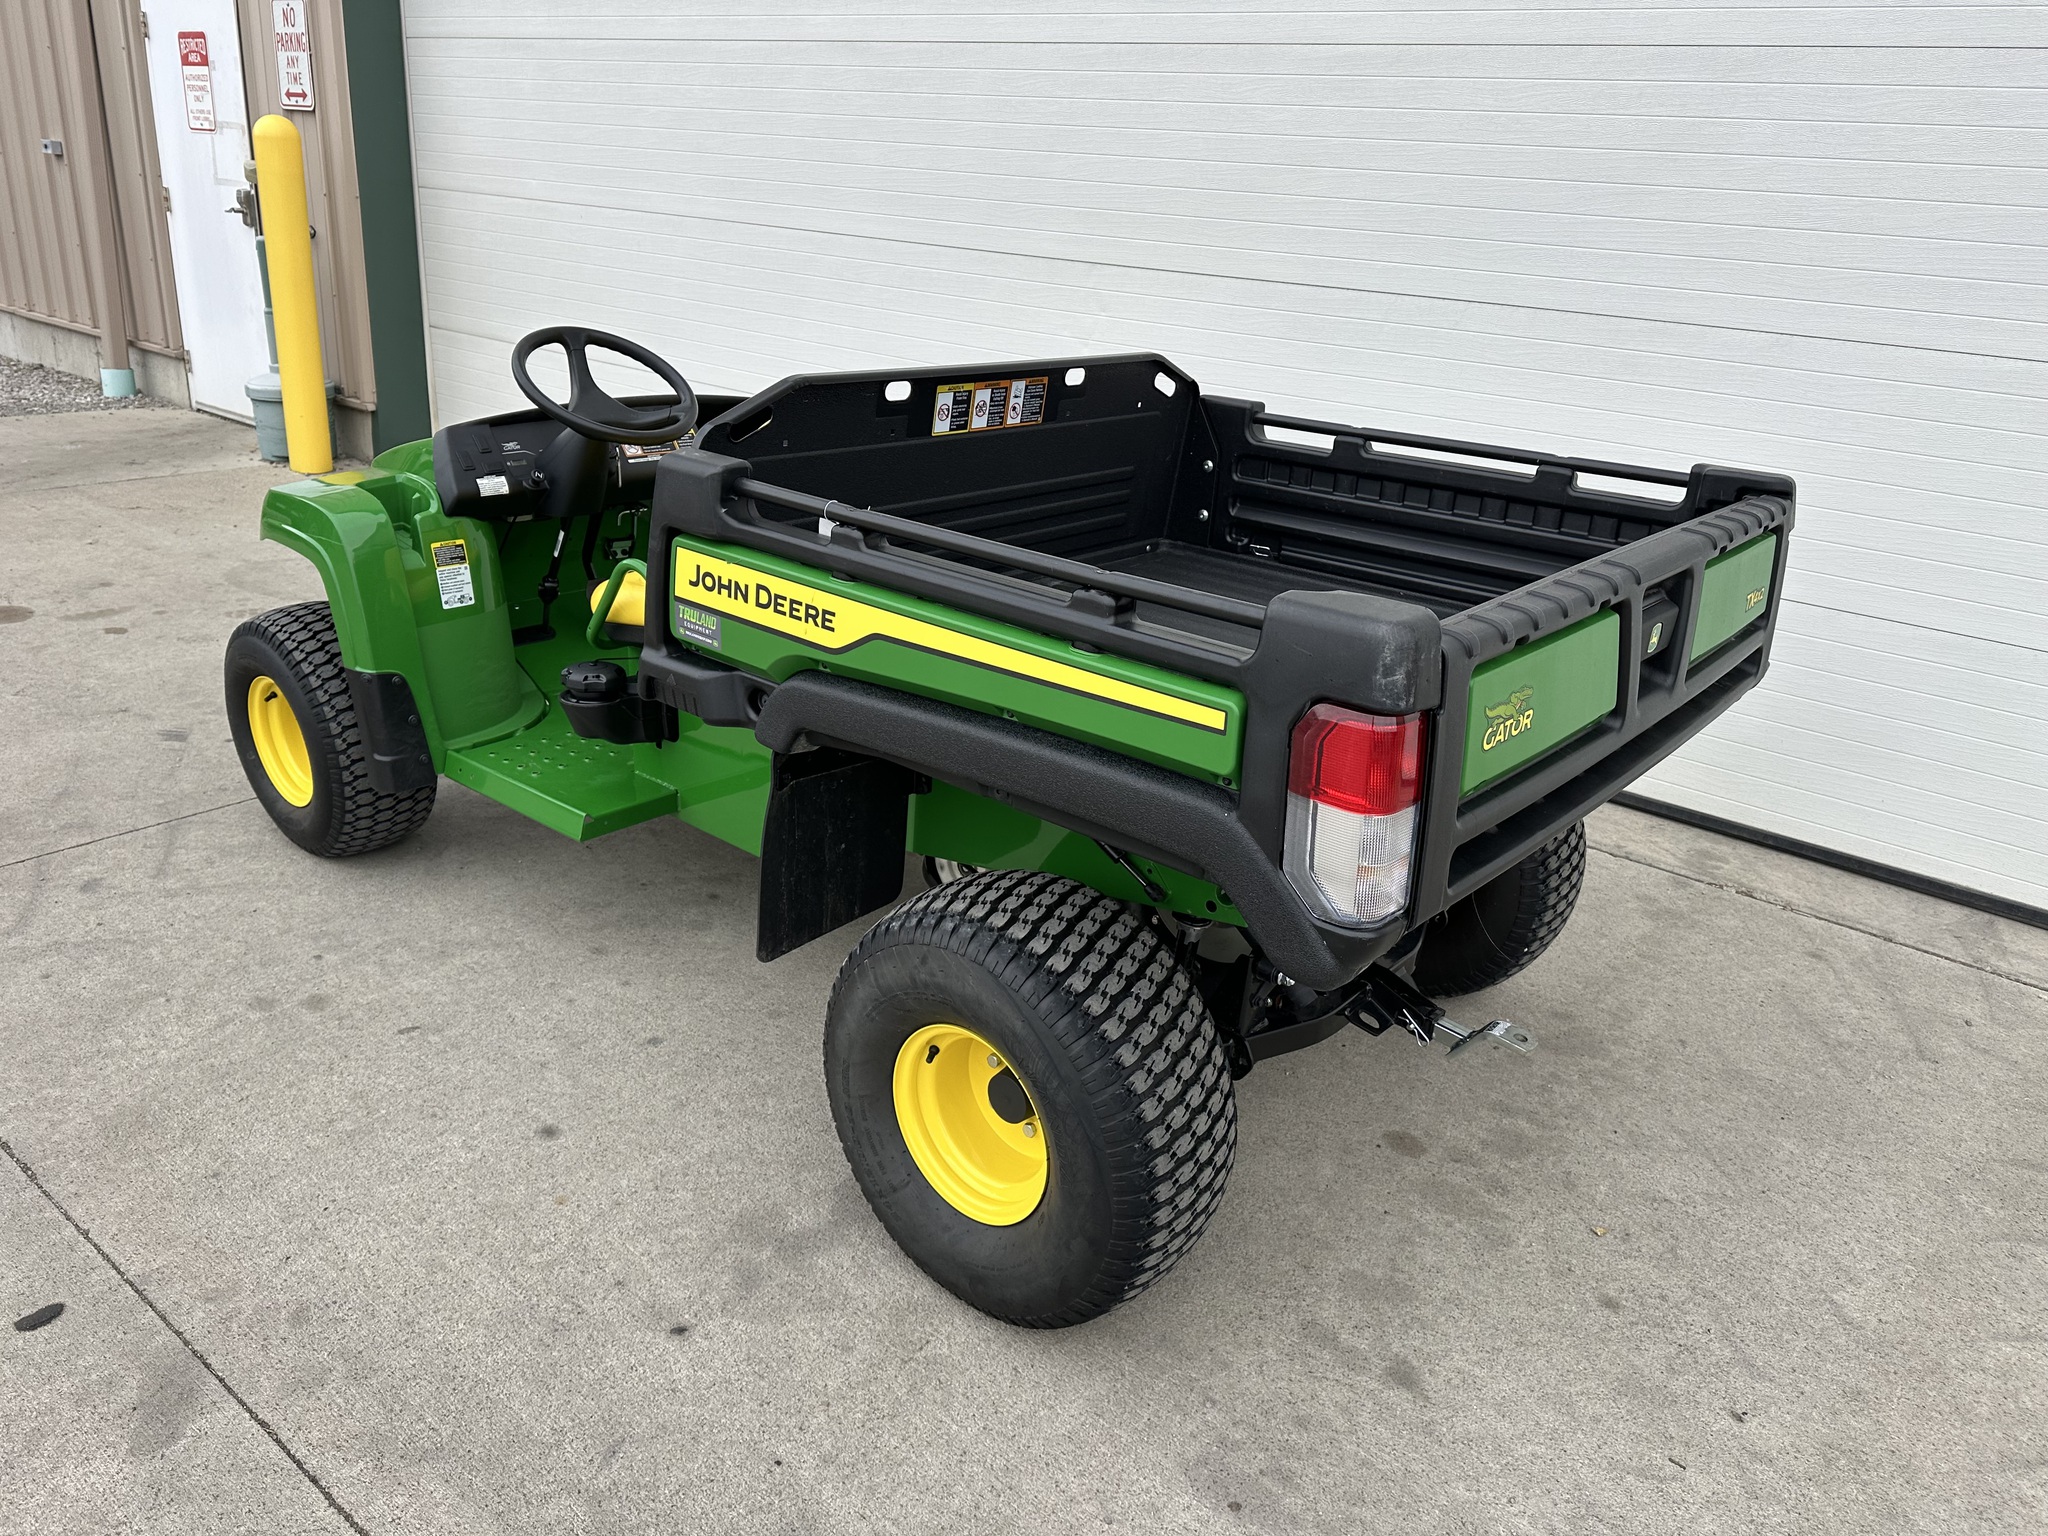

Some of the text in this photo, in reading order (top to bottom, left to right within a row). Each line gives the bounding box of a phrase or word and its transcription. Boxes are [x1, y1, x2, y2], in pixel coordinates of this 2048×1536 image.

[282, 7, 296, 28] NO
[179, 38, 207, 56] RESTRICTED
[275, 32, 306, 53] PARKING
[188, 53, 202, 62] AREA
[286, 56, 299, 69] ANY
[286, 72, 303, 86] TIME
[688, 564, 836, 632] JOHN DEERE
[678, 604, 717, 630] TRULAND
[683, 621, 712, 635] EQUIPMENT
[1483, 708, 1534, 751] GATOR
